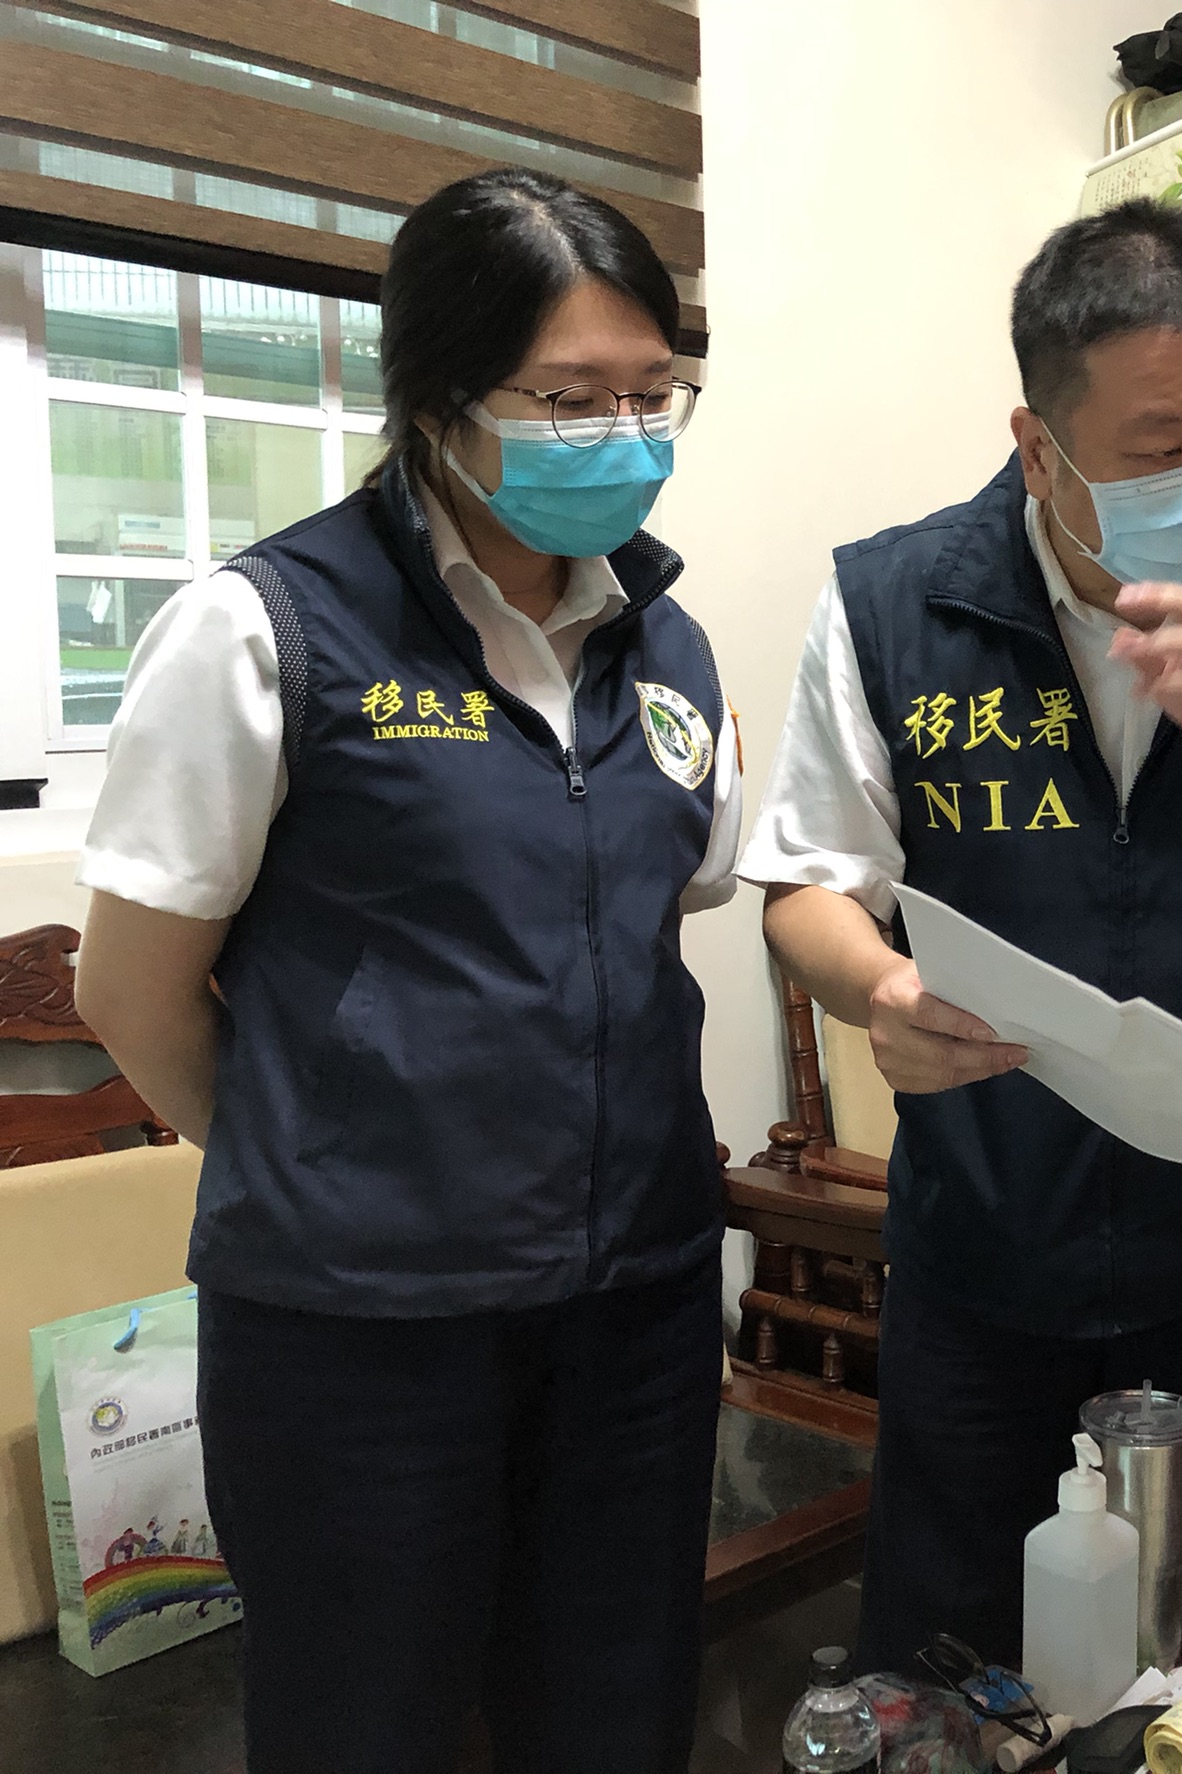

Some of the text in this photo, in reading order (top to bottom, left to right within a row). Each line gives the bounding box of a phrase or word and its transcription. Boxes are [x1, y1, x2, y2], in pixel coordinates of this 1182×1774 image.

[361, 679, 495, 729] 移民署
[904, 686, 1079, 760] 移民署
[372, 724, 490, 742] IMMIGRATION
[914, 777, 1080, 833] NIA
